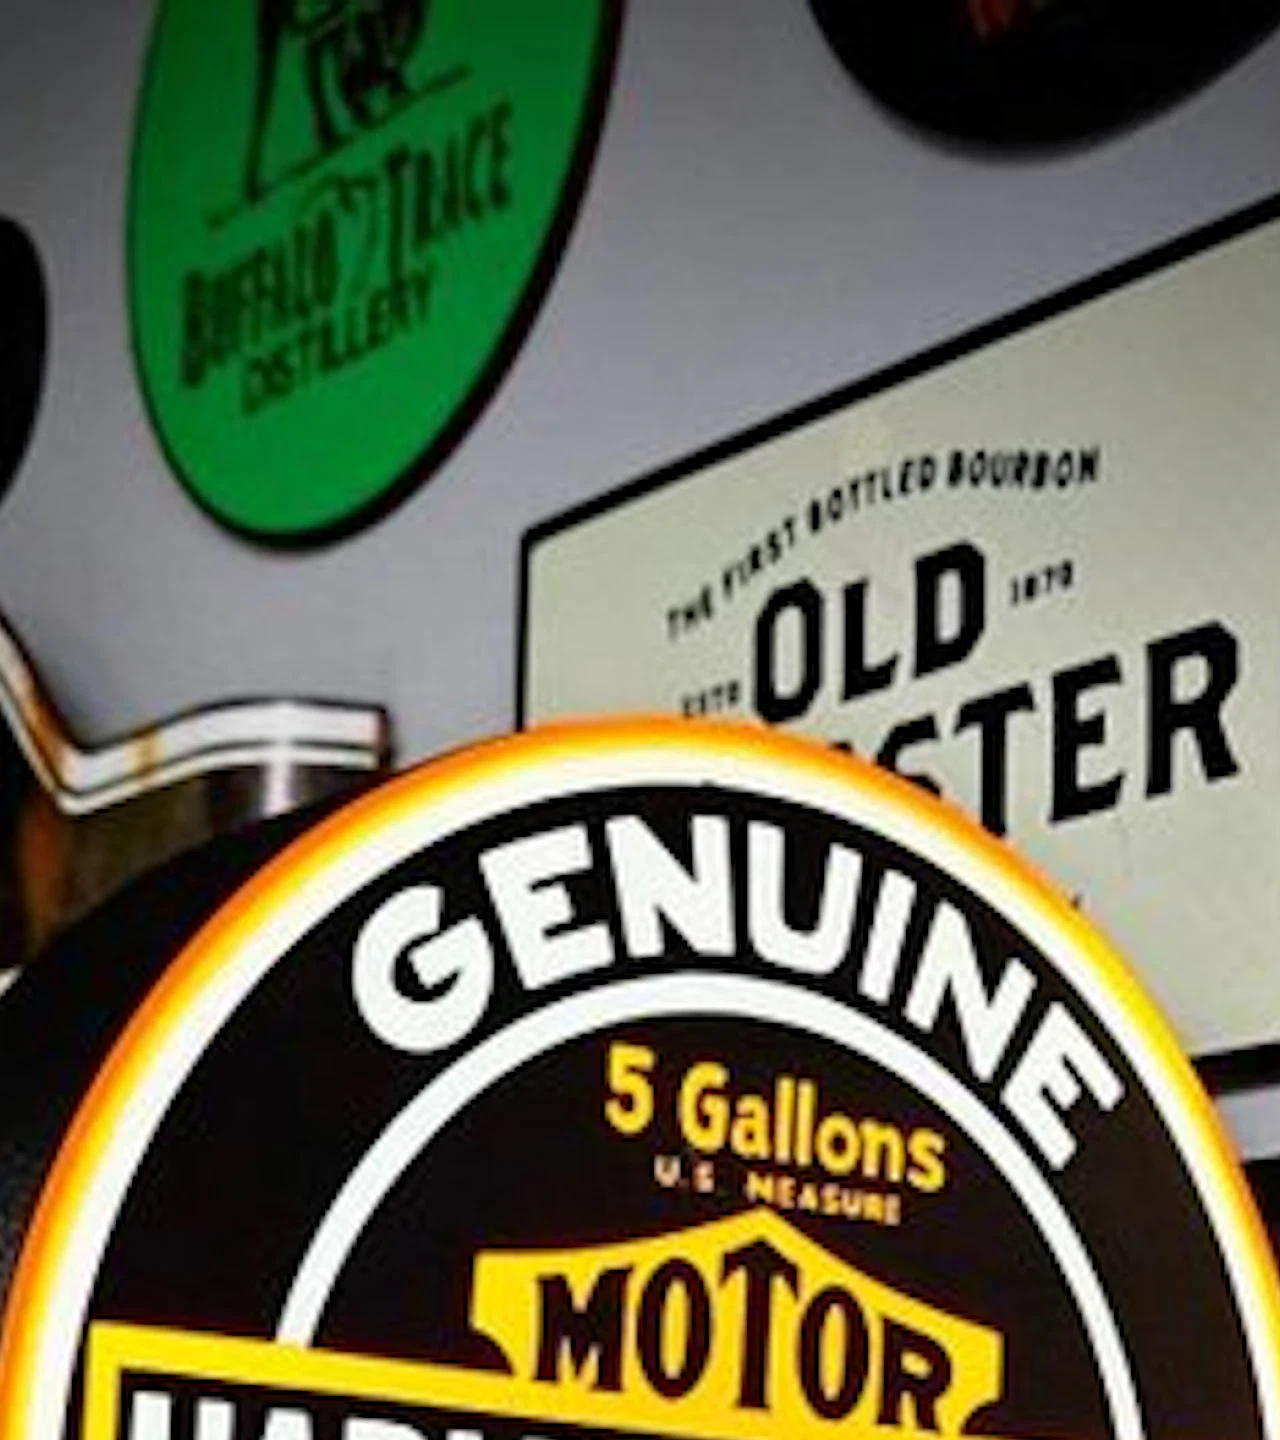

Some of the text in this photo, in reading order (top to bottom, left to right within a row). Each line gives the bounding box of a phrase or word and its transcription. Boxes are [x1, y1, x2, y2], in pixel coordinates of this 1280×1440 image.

[181, 101, 512, 389] BUFFALO TRACE
[242, 258, 436, 415] DISTILLERY
[668, 446, 1100, 639] THE FIRST BOTTLED BOURBON
[755, 541, 985, 723] OLD
[828, 620, 1240, 837] STER
[352, 814, 1125, 1170] GENUINE
[604, 1042, 946, 1193] 5 Gallons
[746, 1172, 901, 1227] MEASURE
[531, 1236, 954, 1432] MOTOR
